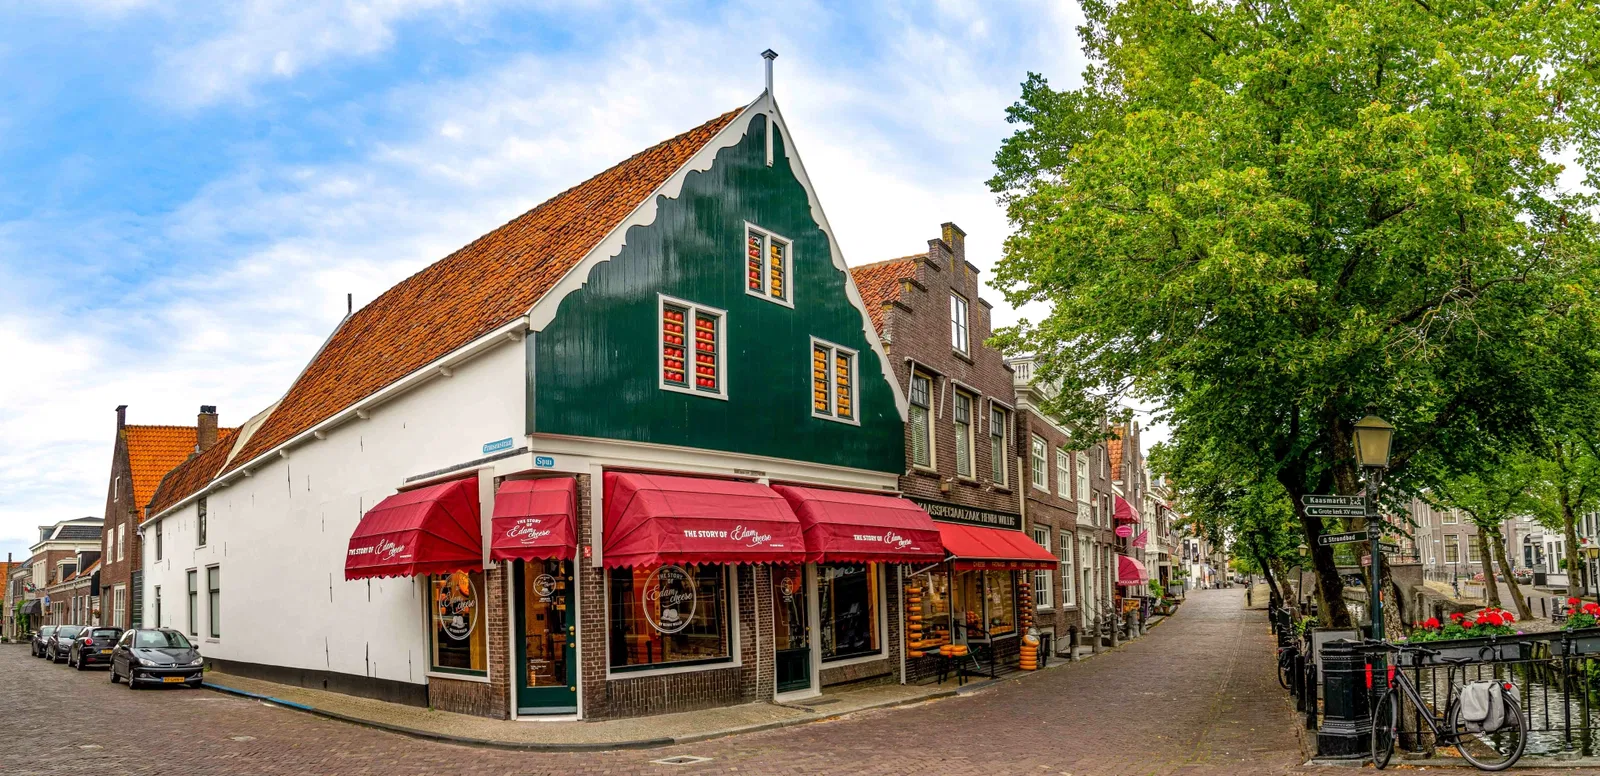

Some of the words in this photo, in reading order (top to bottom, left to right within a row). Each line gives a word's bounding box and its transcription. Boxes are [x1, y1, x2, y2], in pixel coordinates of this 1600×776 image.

[537, 457, 552, 467] Spui
[506, 525, 535, 538] Edam
[524, 529, 550, 540] cheese
[684, 530, 698, 538] THE
[698, 530, 719, 538] STORY
[730, 525, 757, 541] Edam
[883, 531, 902, 544] Edam
[749, 532, 772, 546] cheese
[1328, 534, 1356, 543] Strandbad
[368, 546, 374, 554] OF
[374, 538, 395, 555] Edam
[385, 545, 405, 559] cheese
[667, 572, 684, 580] STORY
[646, 583, 675, 601] Edam
[666, 590, 693, 606] cheese
